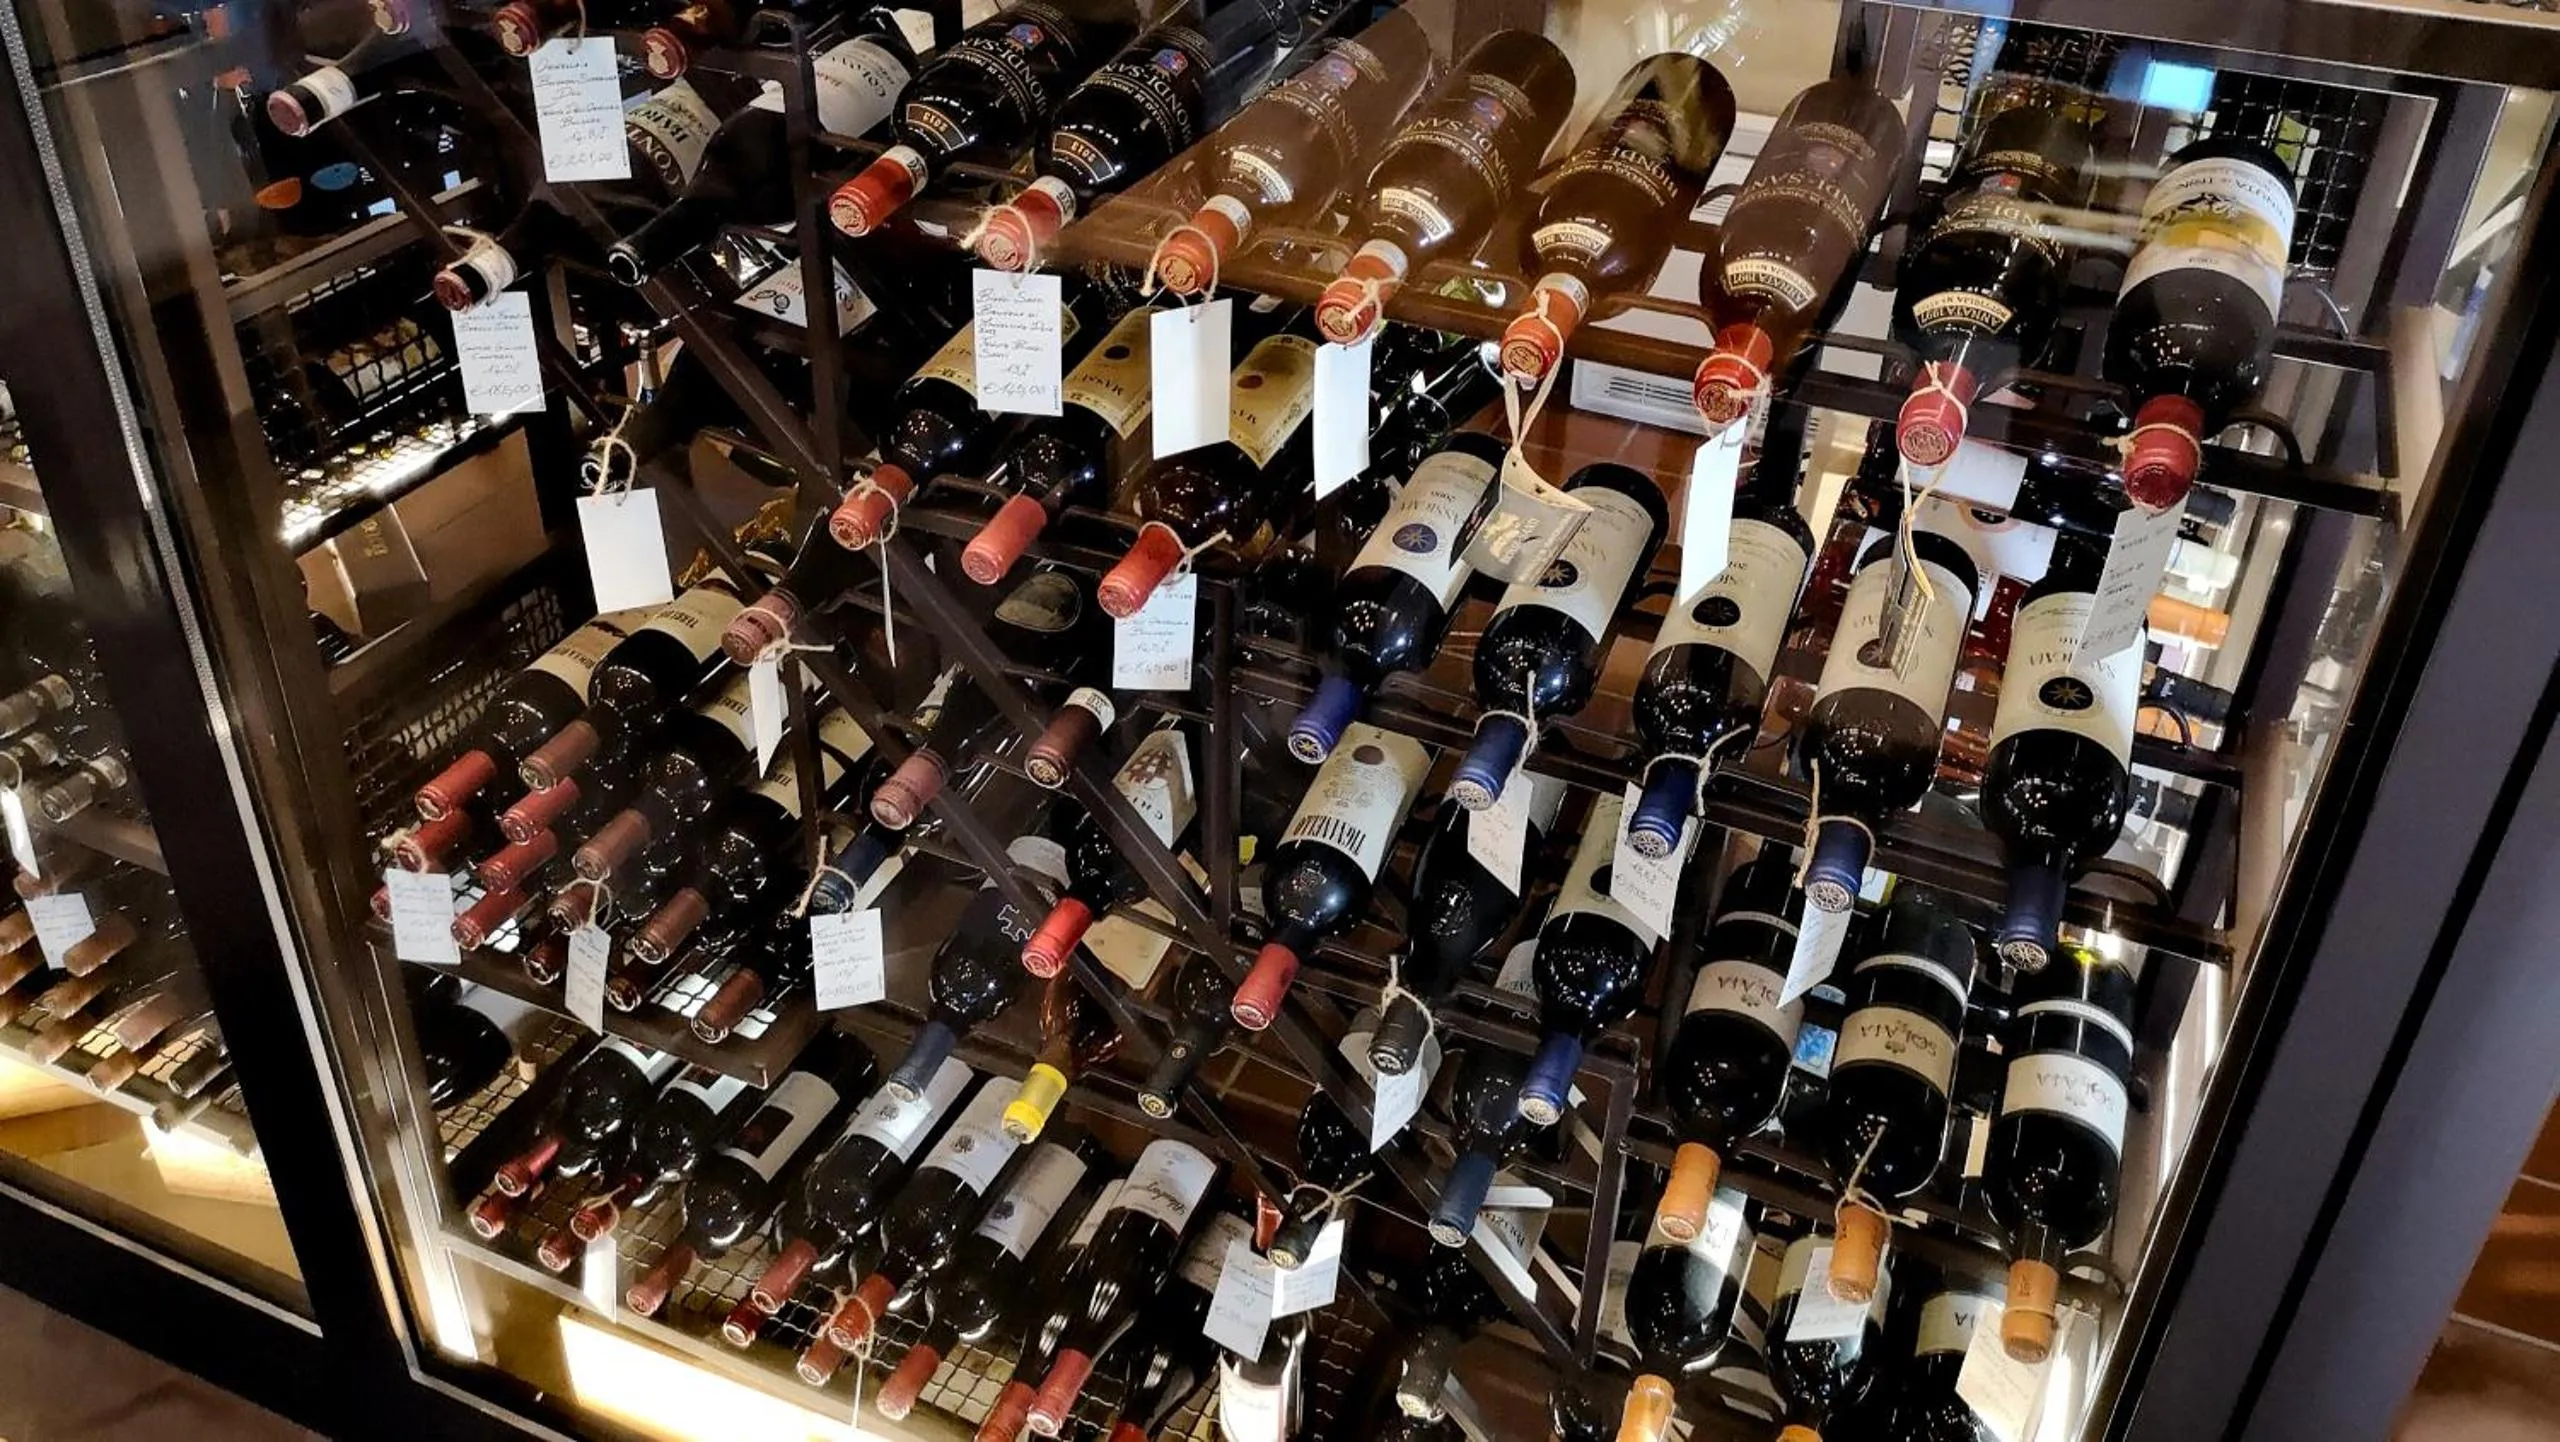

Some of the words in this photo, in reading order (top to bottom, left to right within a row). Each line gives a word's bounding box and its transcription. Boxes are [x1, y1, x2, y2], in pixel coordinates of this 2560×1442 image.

[922, 110, 949, 132] 2013
[1071, 140, 1097, 163] 2013
[1860, 1020, 1937, 1058] SOLAIA
